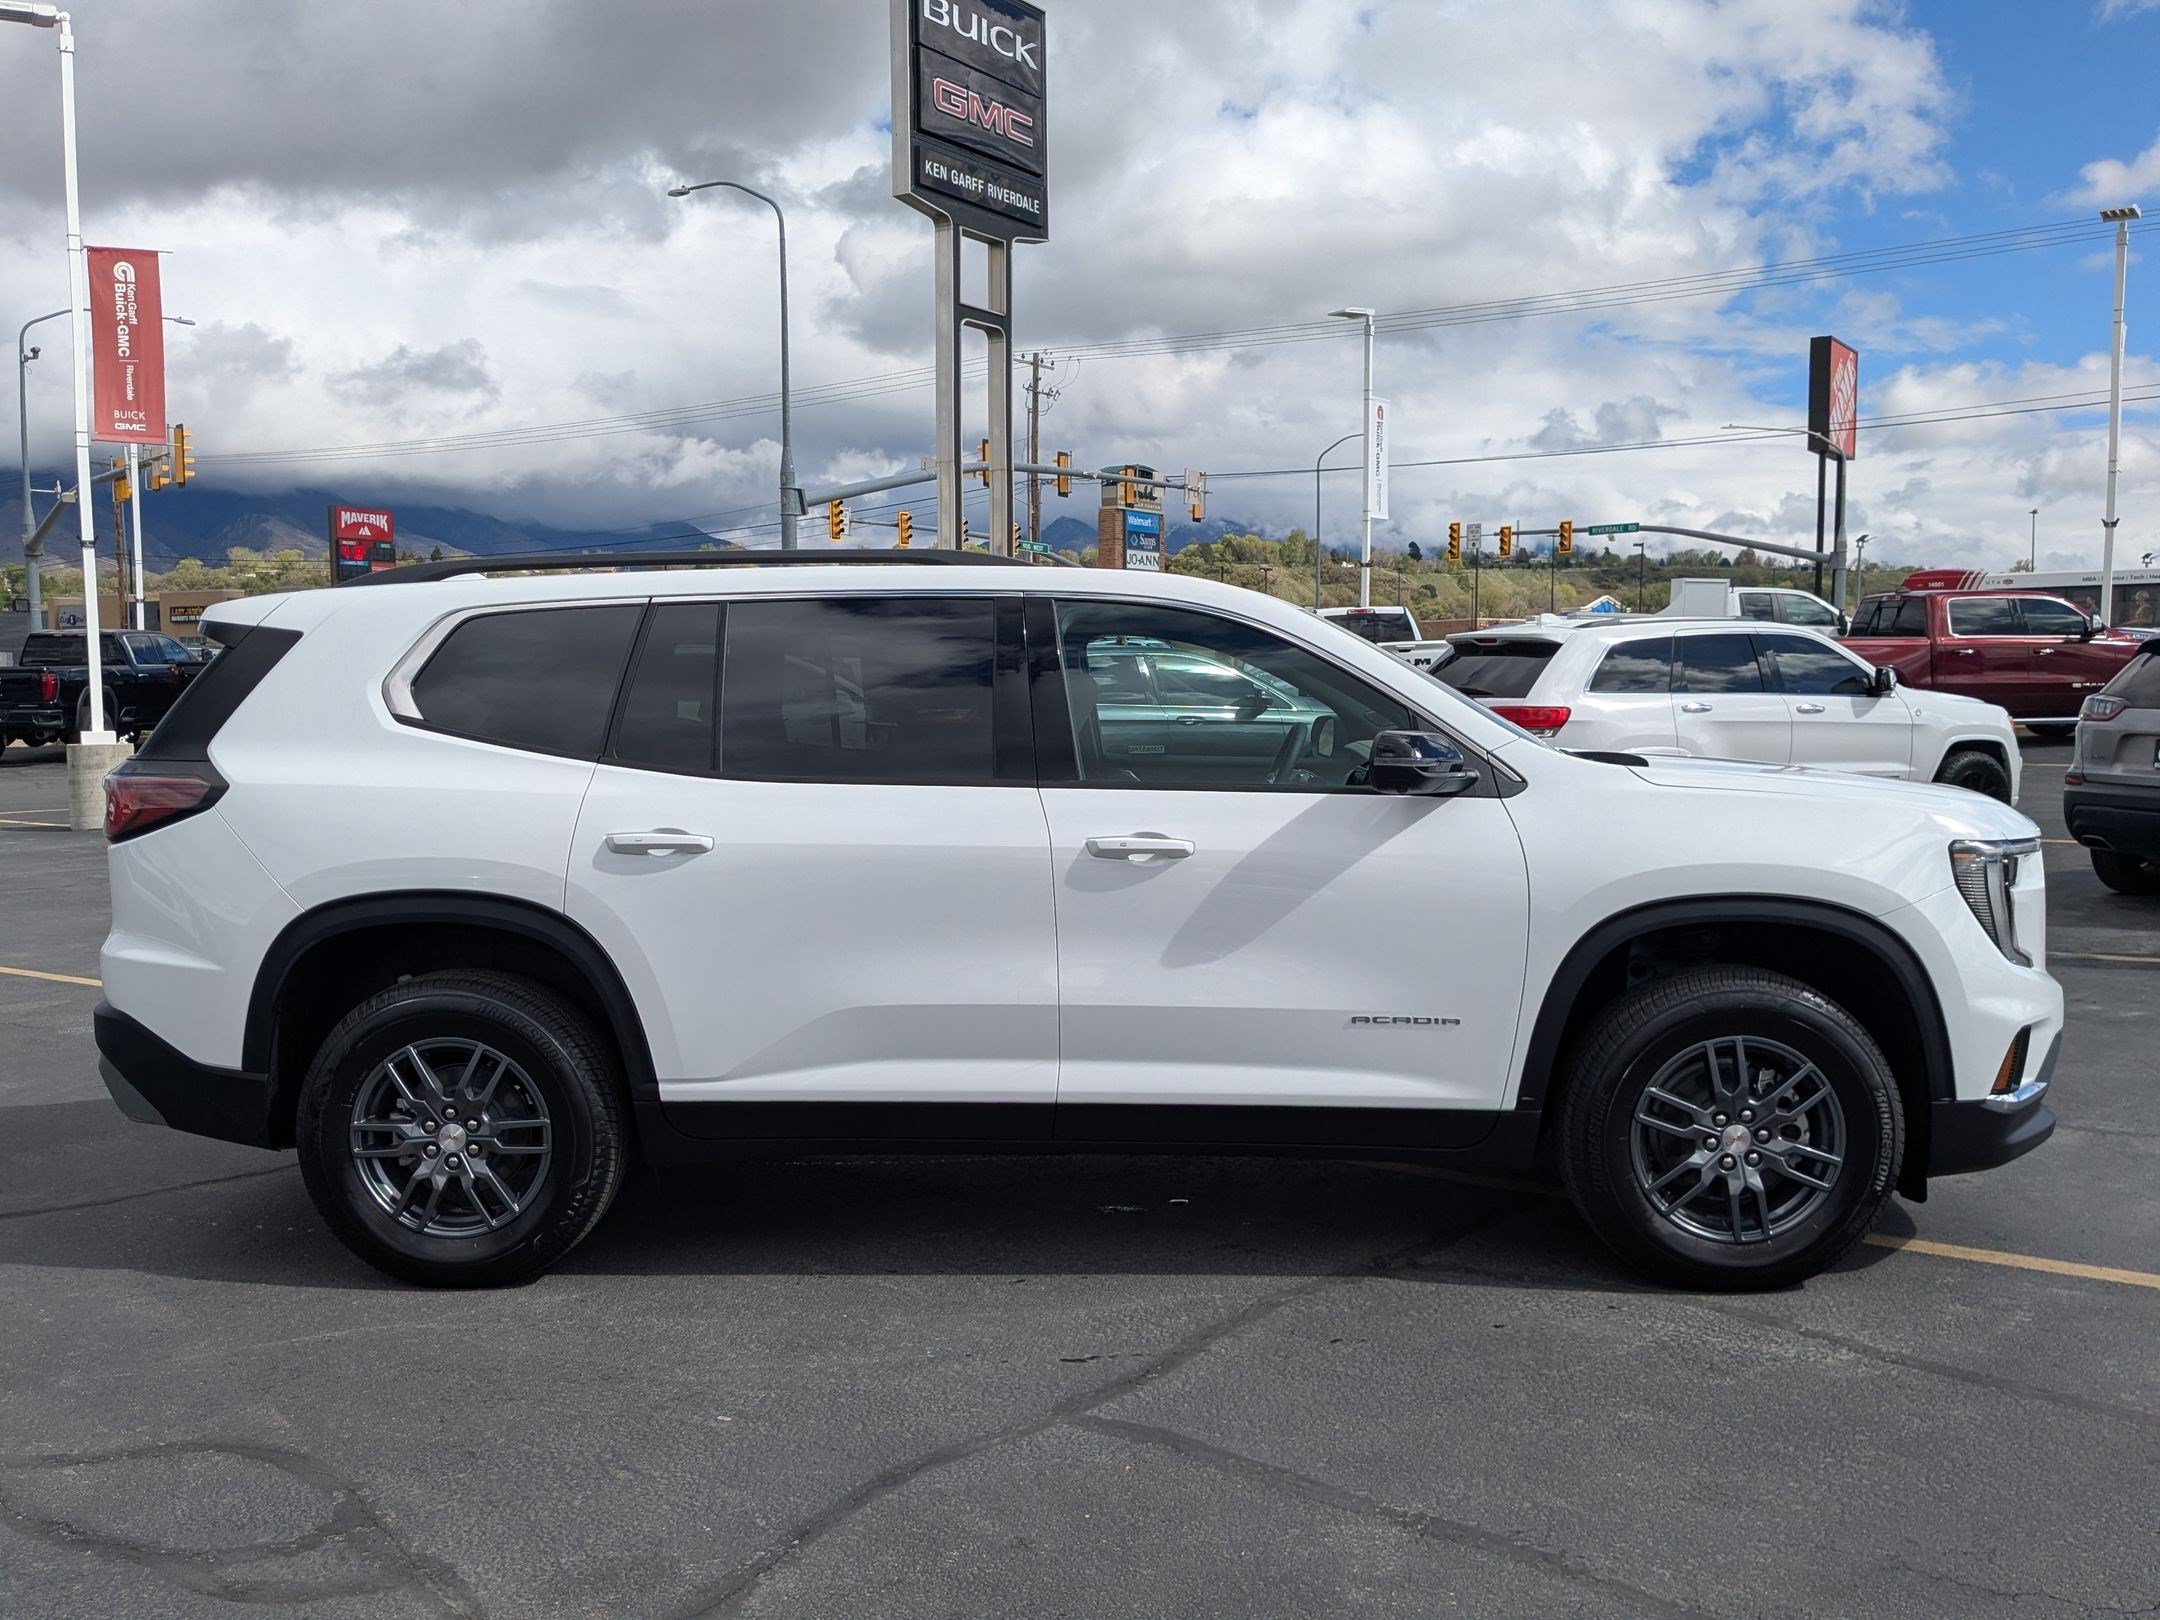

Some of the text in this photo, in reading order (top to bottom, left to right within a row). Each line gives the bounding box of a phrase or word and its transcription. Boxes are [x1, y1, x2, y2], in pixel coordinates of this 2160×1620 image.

[924, 0, 1038, 71] BUICK
[933, 77, 1033, 147] GMC
[925, 159, 1040, 214] KEN GARFF RIVERDALE
[127, 283, 138, 325] Ken Garff
[126, 365, 135, 401] Riverdale
[114, 409, 146, 420] BUICK
[115, 422, 147, 431] GMC
[341, 511, 389, 533] MAVERIK
[1128, 515, 1152, 527] Walmart
[1591, 525, 1625, 534] RIVERDALE
[1351, 1016, 1461, 1026] ACADIA
[1872, 1088, 1894, 1196] BRIDGESTONE
